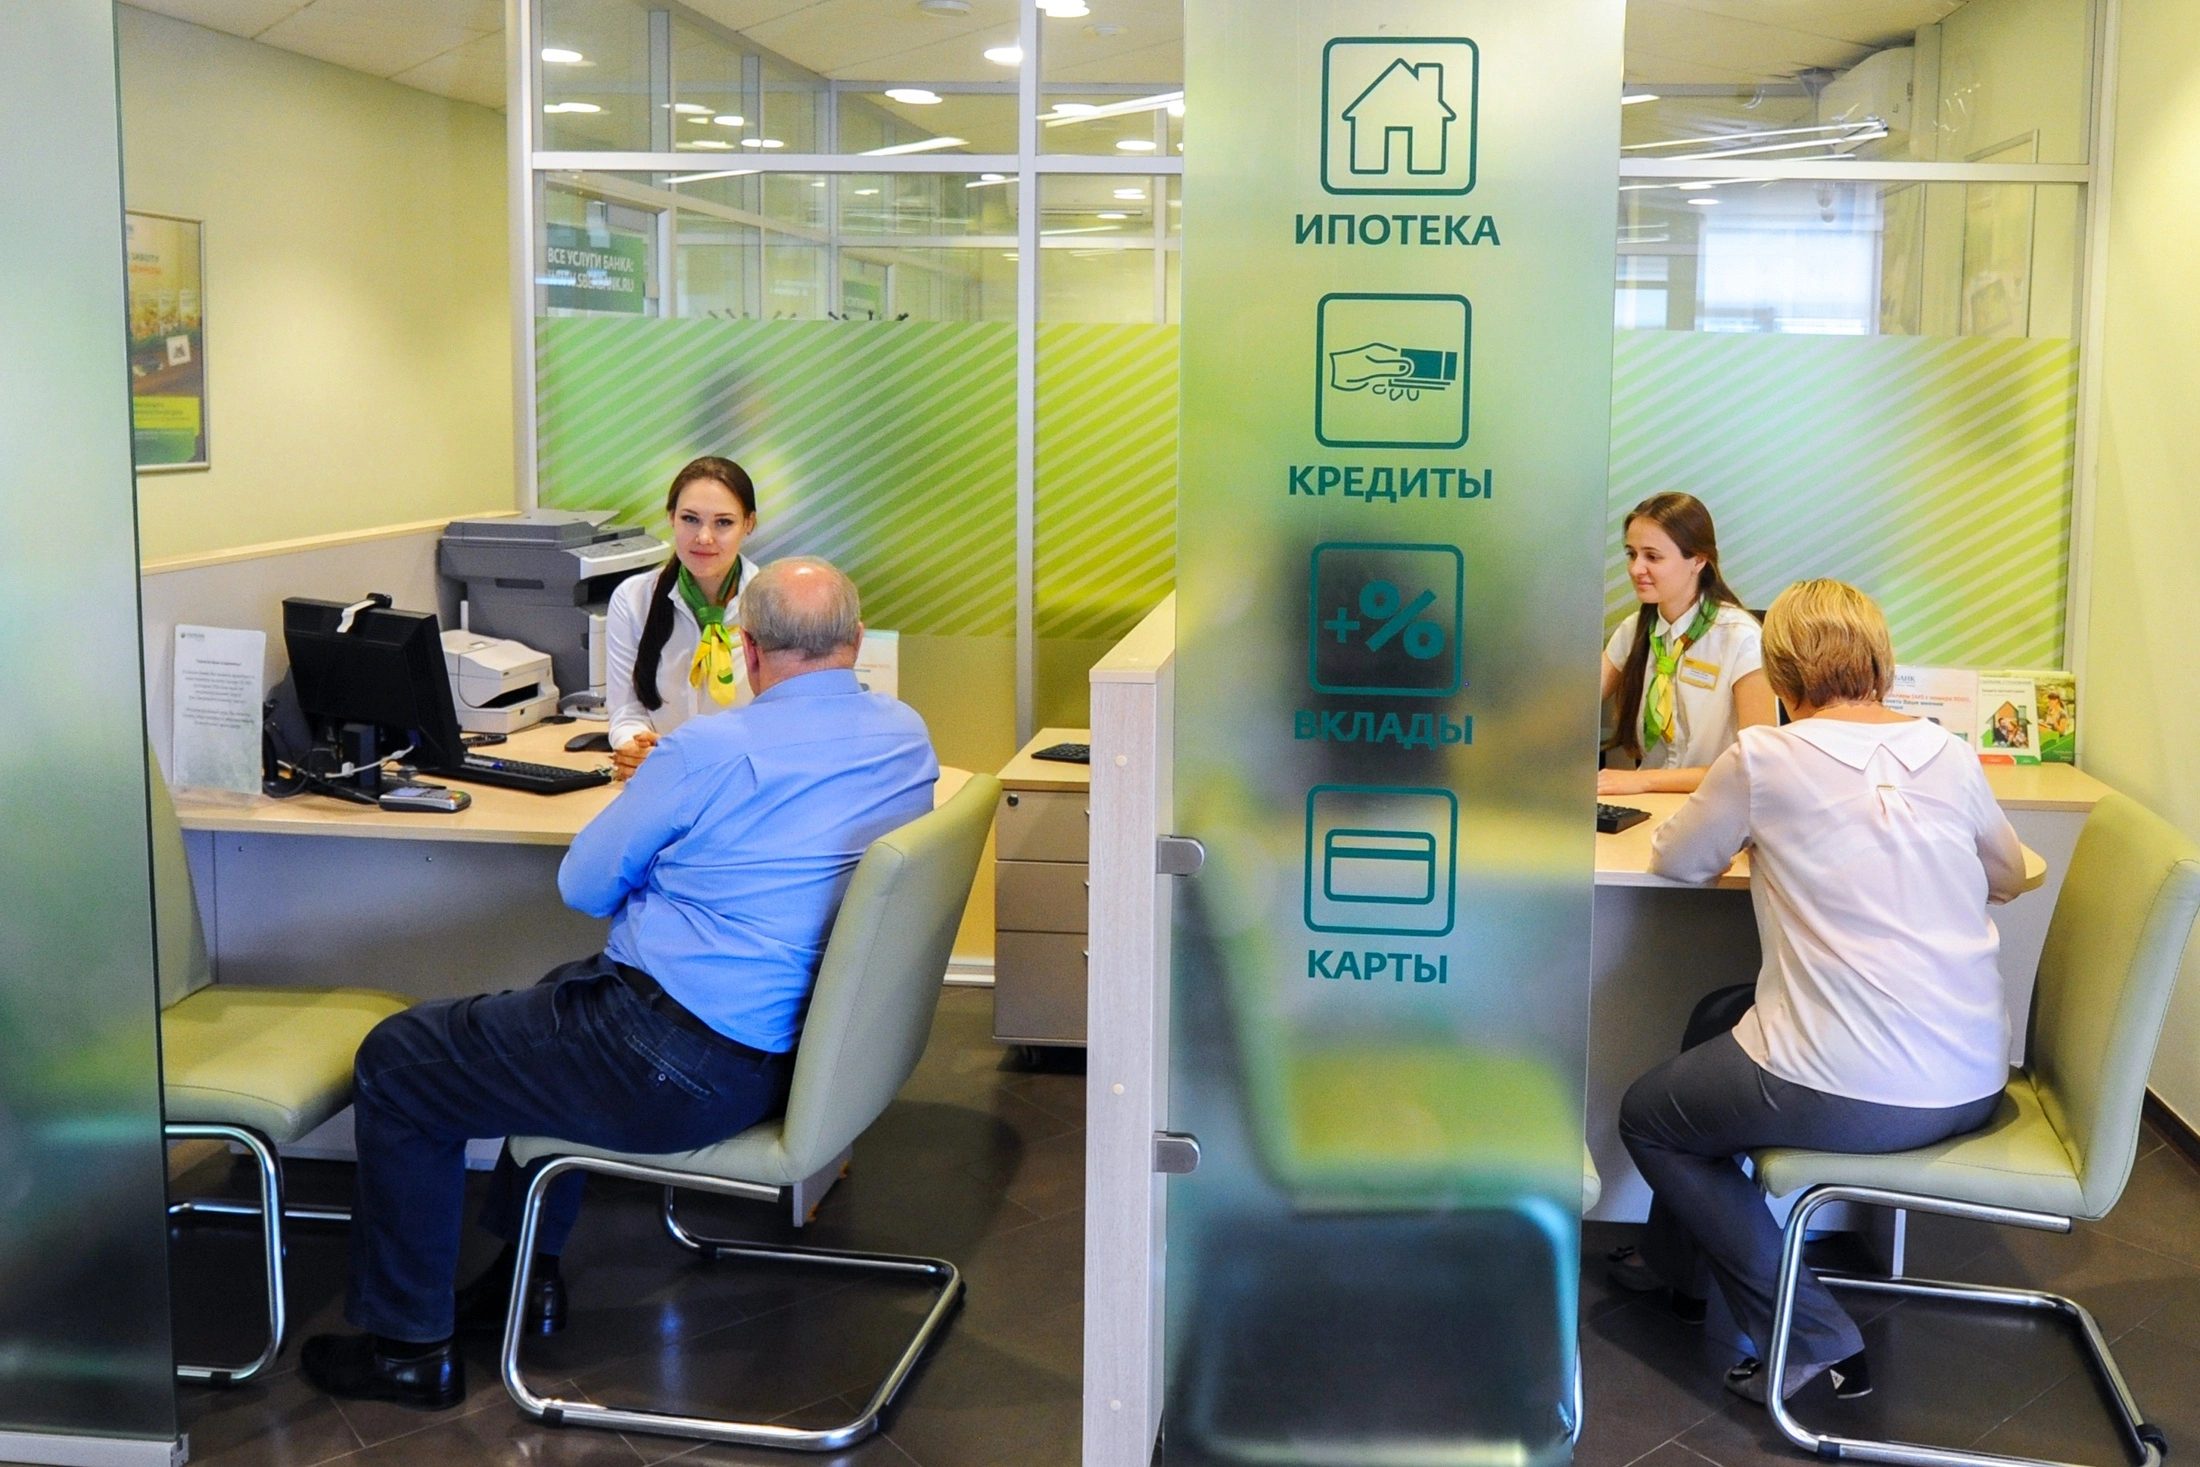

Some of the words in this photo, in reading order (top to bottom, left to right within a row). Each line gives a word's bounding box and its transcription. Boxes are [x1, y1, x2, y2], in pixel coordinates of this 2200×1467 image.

[1295, 214, 1501, 246] ИПОТЕКА
[547, 247, 566, 264] ВСЕ
[567, 250, 601, 269] УСЛУГИ
[603, 255, 634, 272] БАНКА:
[1289, 465, 1492, 503] КРЕДИТЫ
[1294, 710, 1473, 750] ВКЛАДЫ
[1307, 949, 1448, 984] КАРТЫ
